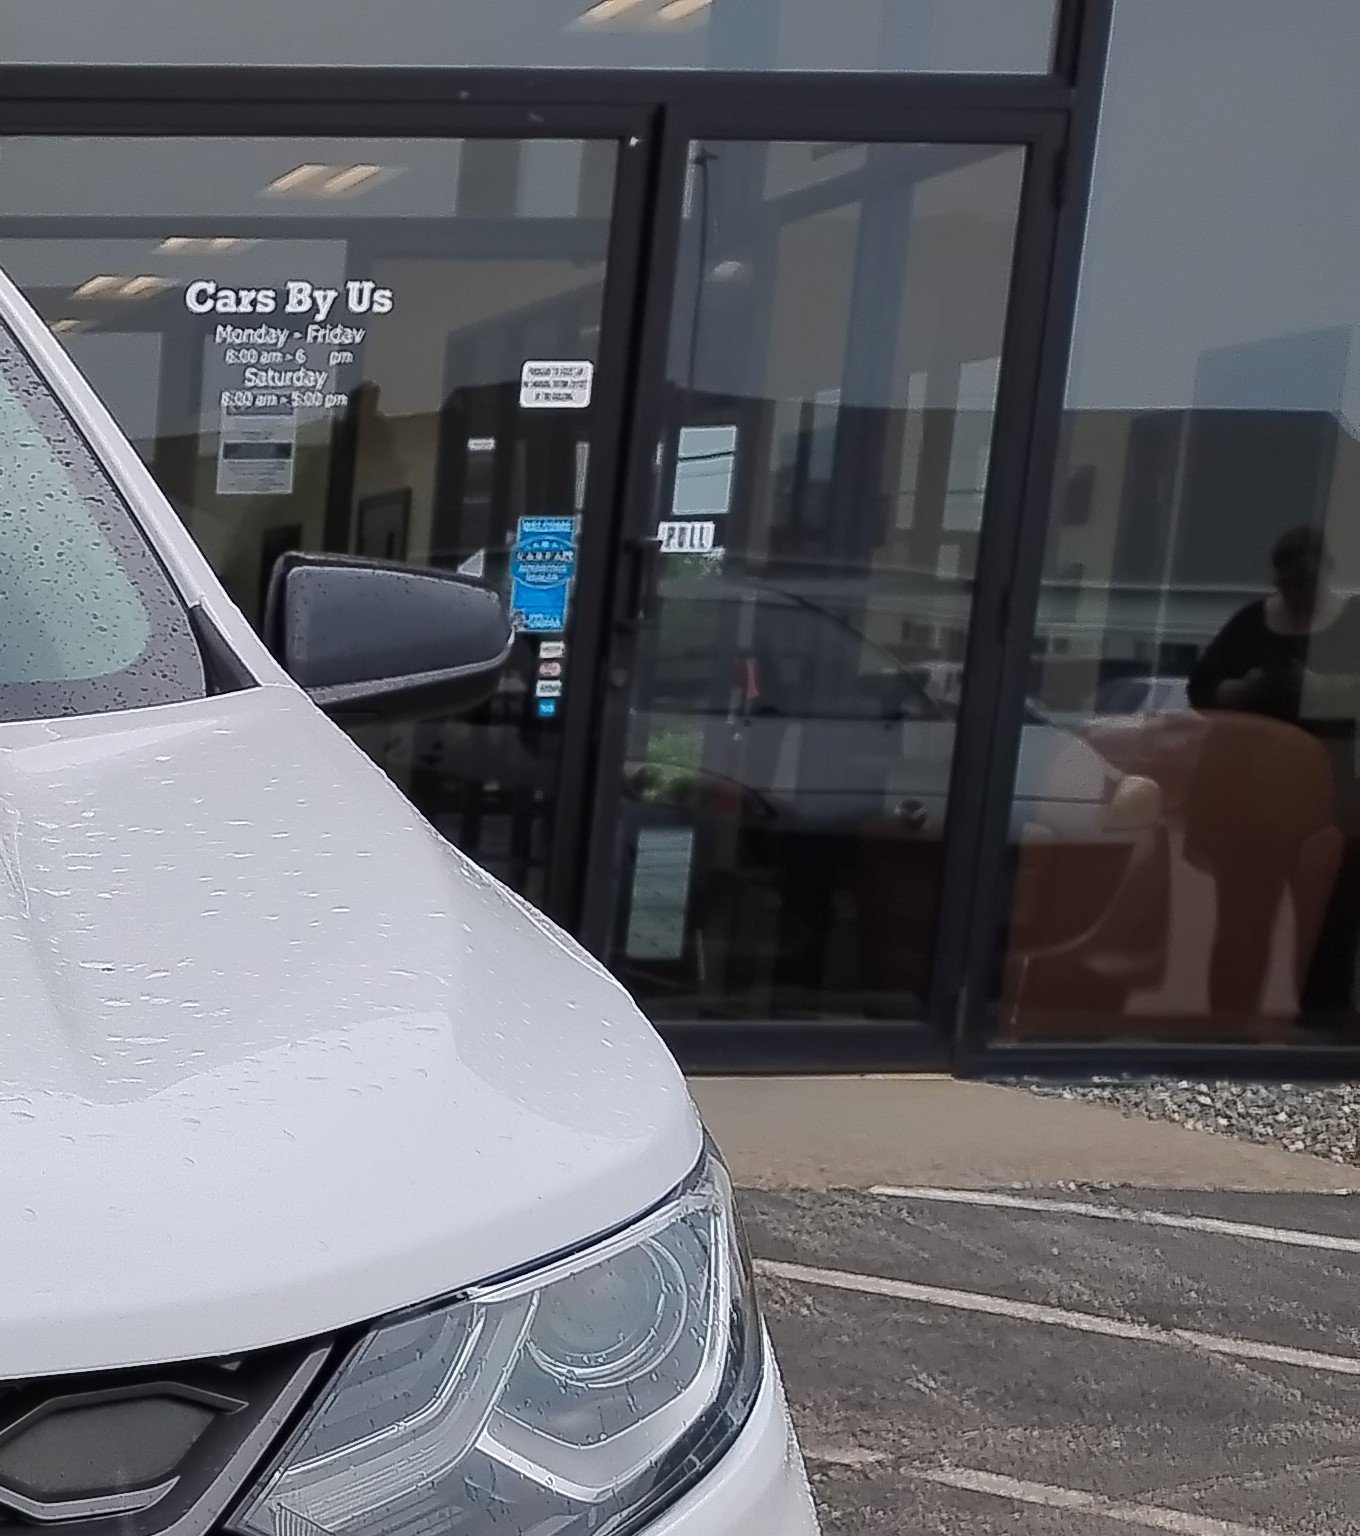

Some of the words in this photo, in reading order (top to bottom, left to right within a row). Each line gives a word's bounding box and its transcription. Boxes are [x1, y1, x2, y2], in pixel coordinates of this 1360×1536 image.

[185, 280, 276, 313] Cars
[284, 280, 338, 322] By
[346, 280, 393, 313] Us
[215, 324, 289, 347] Monday
[306, 324, 366, 344] Friday
[260, 351, 283, 364] am
[329, 350, 353, 366] pm
[244, 366, 328, 390] Saturday
[255, 394, 278, 406] am
[325, 394, 348, 408] pm
